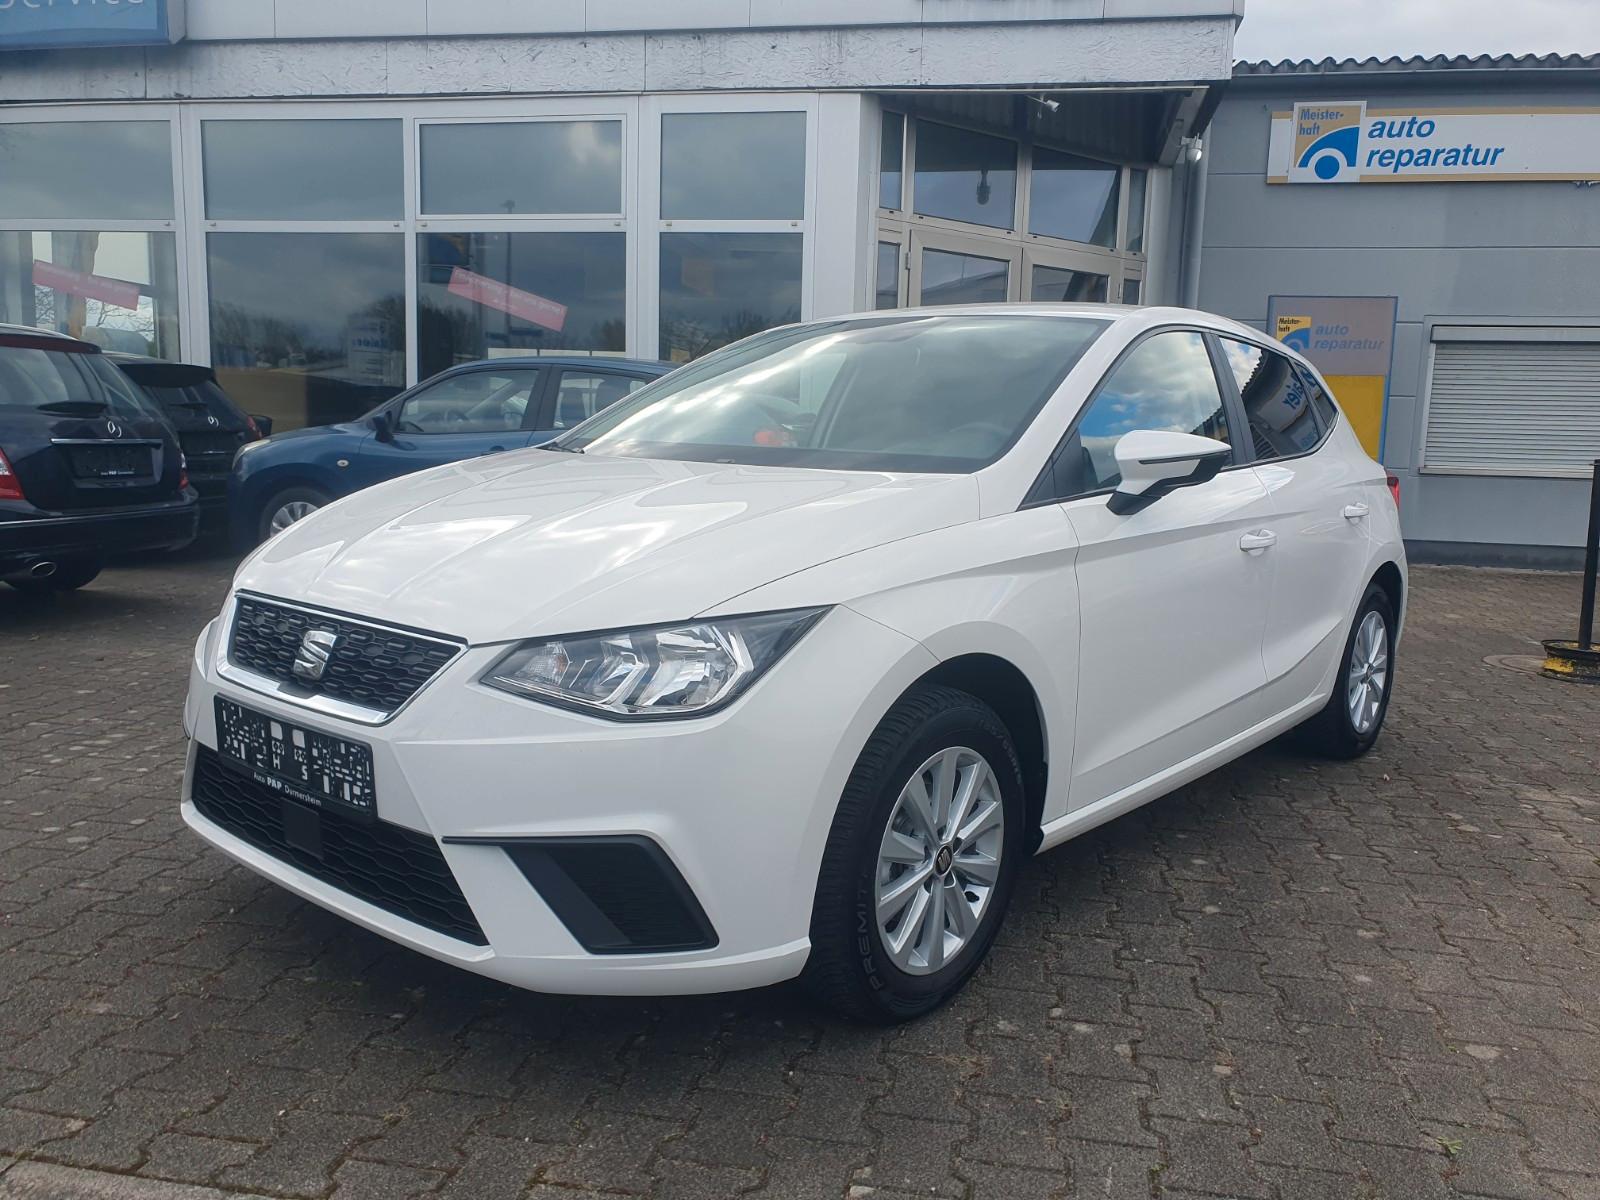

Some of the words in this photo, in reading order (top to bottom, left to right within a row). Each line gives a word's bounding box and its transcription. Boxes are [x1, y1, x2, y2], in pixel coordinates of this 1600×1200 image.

[1300, 108, 1344, 121] Meister-
[1299, 122, 1321, 136] haft
[1368, 116, 1435, 139] auto
[1366, 144, 1505, 173] reparatur
[1315, 324, 1349, 336] auto
[1313, 339, 1385, 351] reparatur
